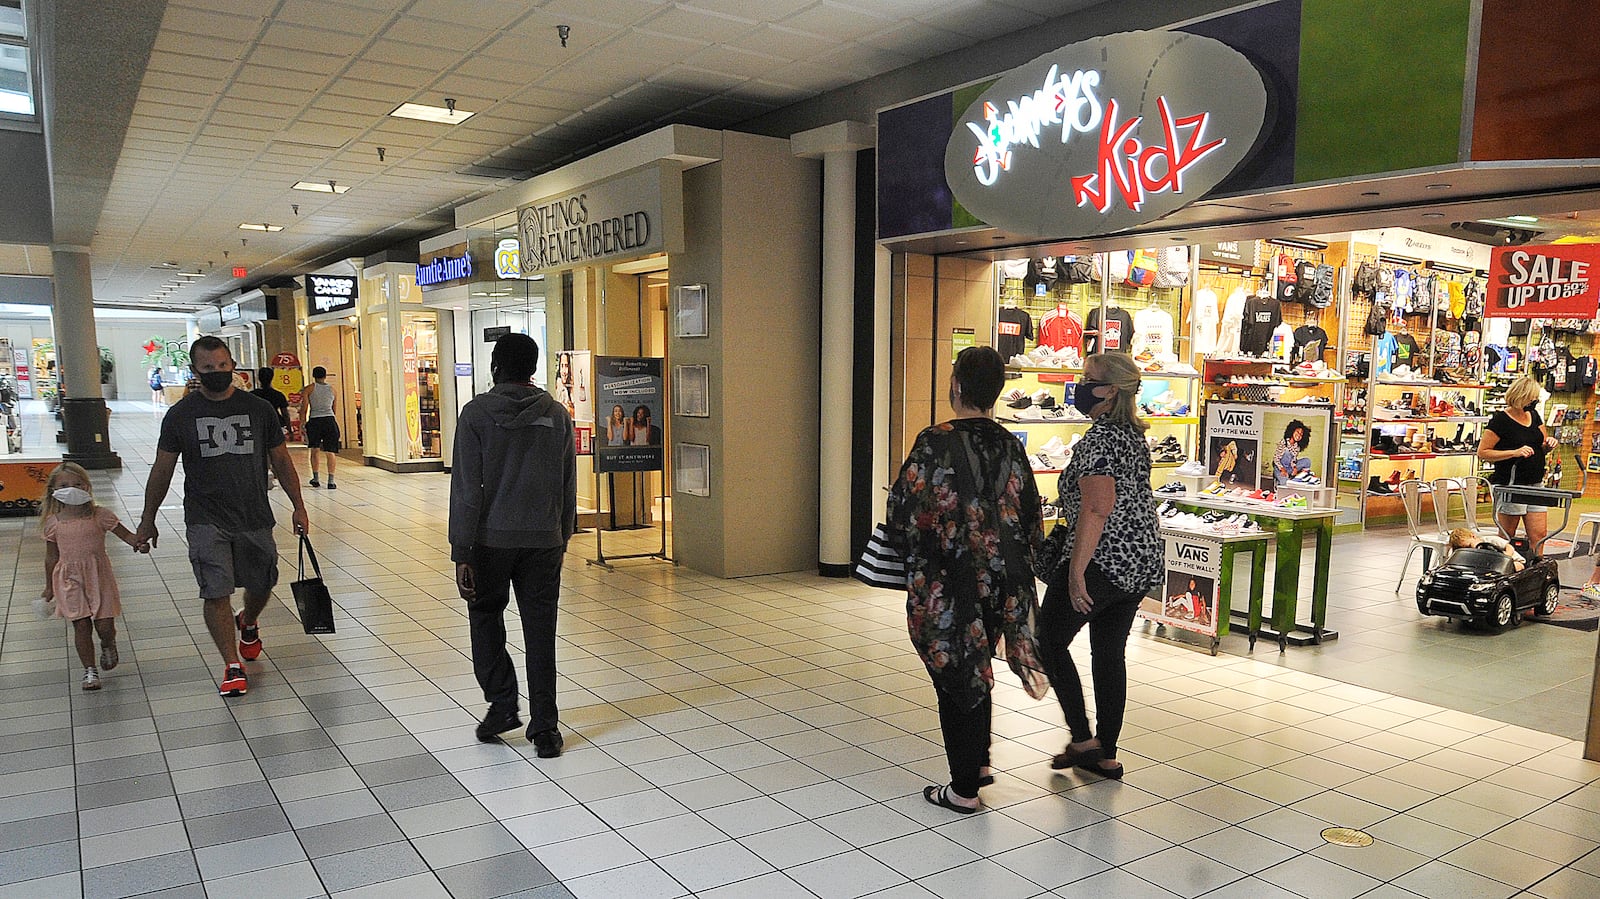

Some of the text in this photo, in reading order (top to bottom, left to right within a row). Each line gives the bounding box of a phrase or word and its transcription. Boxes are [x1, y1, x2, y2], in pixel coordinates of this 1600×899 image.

[966, 64, 1102, 187] Journeys
[1071, 96, 1227, 214] Kidz
[538, 193, 590, 229] THINGS
[539, 211, 650, 268] REMEMBERED
[1217, 241, 1239, 252] VANS
[1509, 250, 1590, 285] SALE
[1507, 282, 1590, 309] UP TO 50%
[1562, 288, 1588, 298] OFF
[404, 360, 416, 374] SALE
[604, 377, 652, 388] PERSONALIZATION
[1218, 409, 1254, 426] VANS
[195, 414, 254, 458] DC
[1175, 542, 1210, 563] VANS
[1183, 562, 1195, 570] THE
